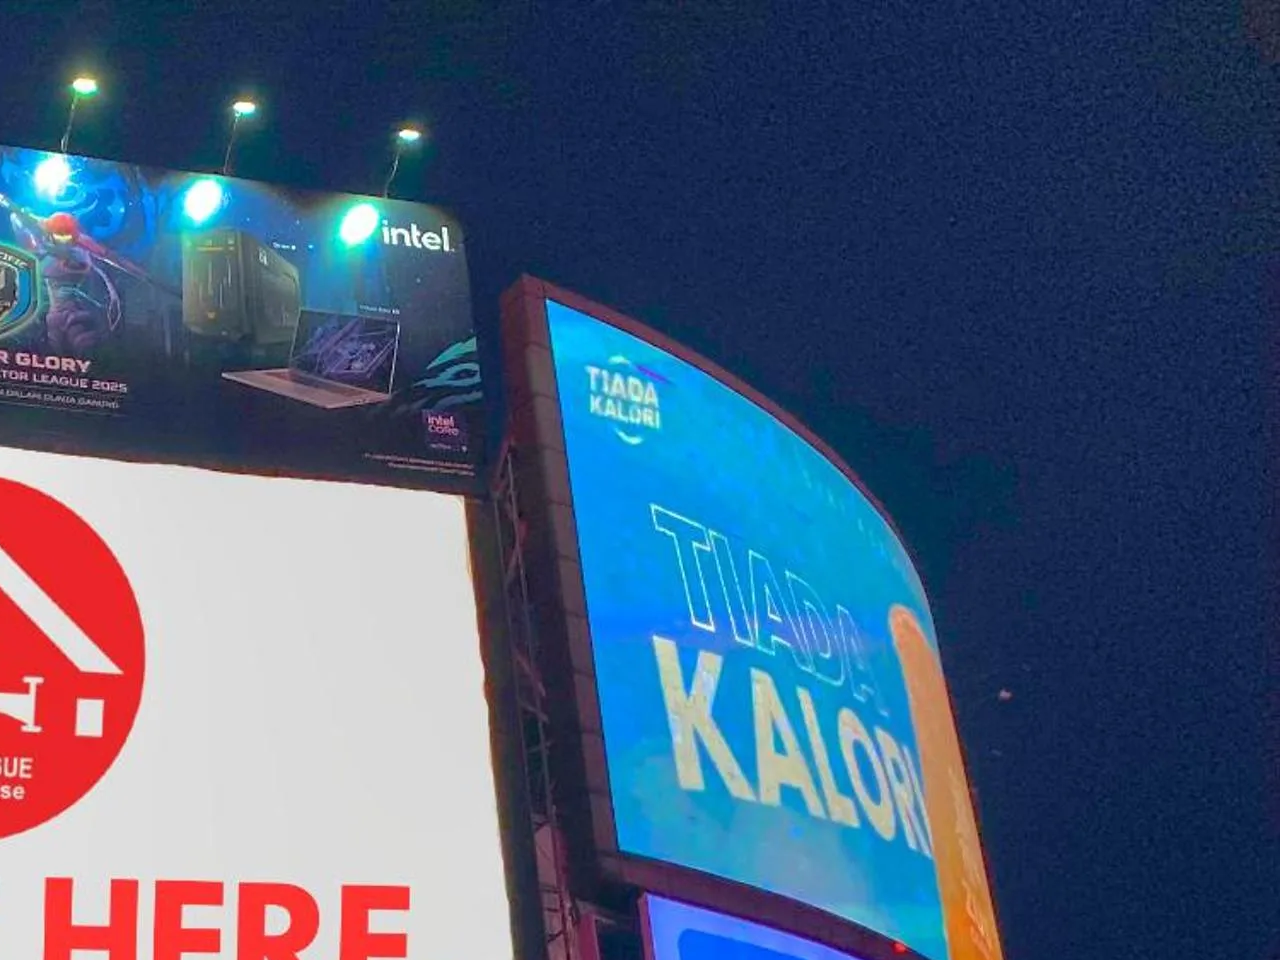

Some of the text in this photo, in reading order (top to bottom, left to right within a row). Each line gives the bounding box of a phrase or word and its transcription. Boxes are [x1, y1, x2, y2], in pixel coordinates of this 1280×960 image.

[15, 352, 92, 373] GLORY
[33, 373, 88, 389] LEAGUE
[91, 380, 128, 393] 2025
[585, 364, 659, 405] TIADA
[588, 394, 661, 429] KALORI
[649, 503, 890, 717] TIADA
[652, 635, 934, 860] KALORI
